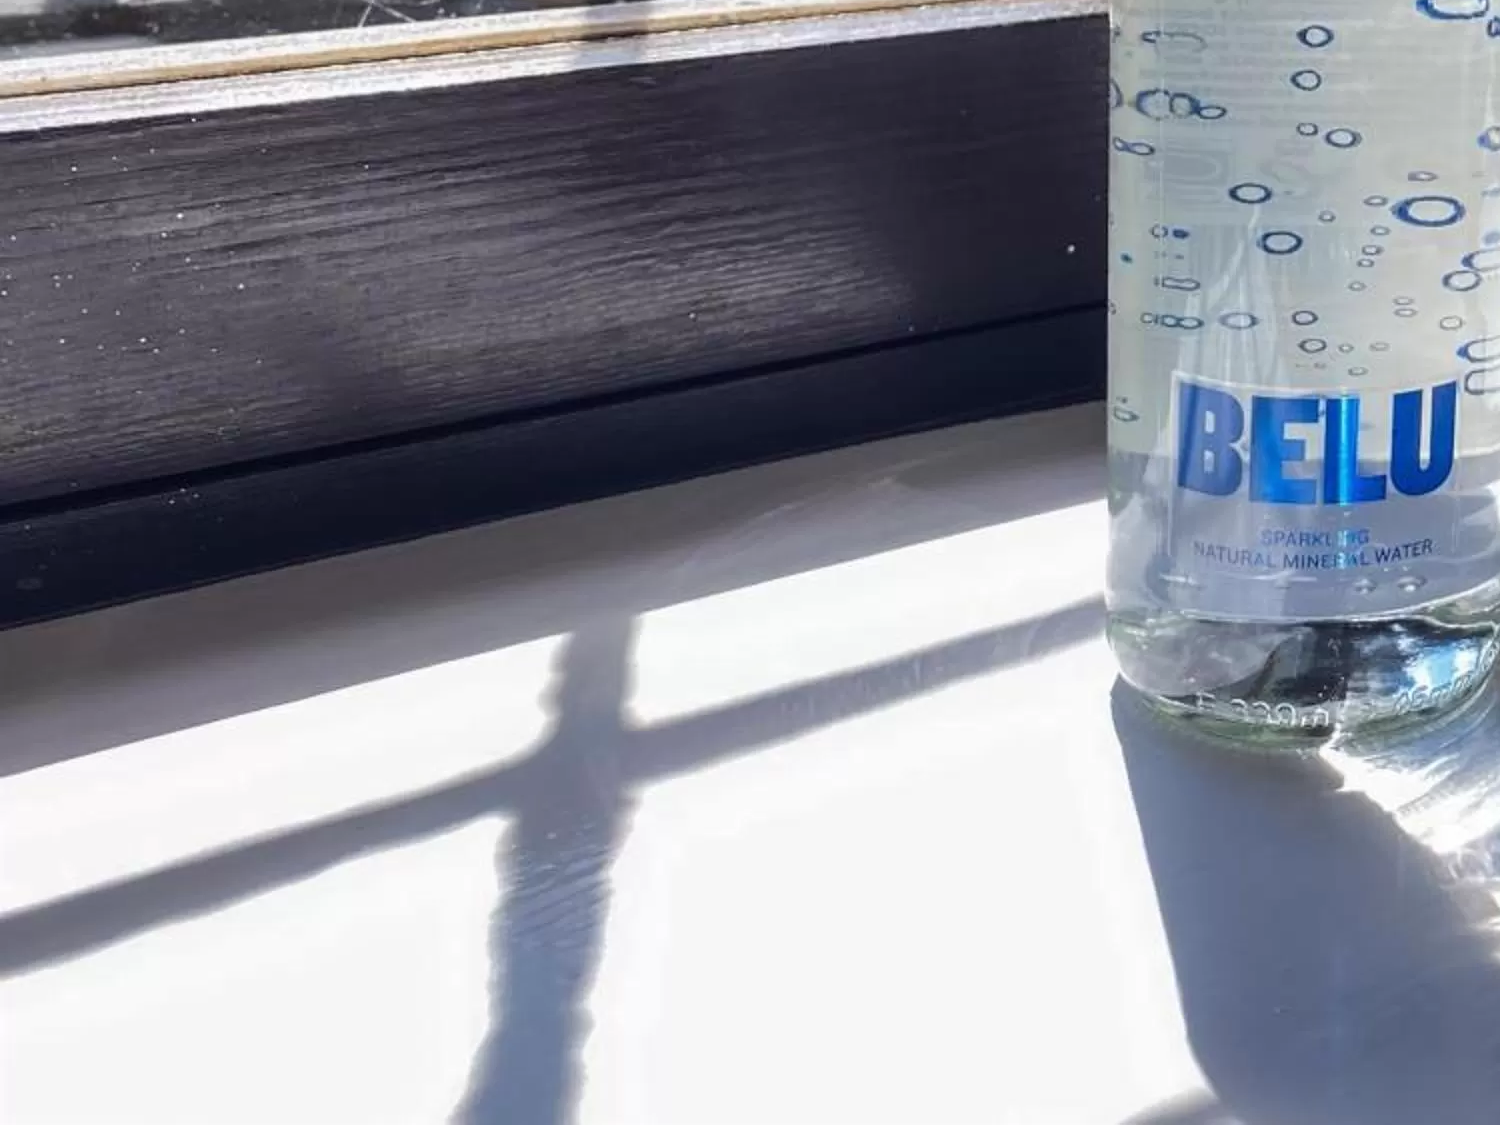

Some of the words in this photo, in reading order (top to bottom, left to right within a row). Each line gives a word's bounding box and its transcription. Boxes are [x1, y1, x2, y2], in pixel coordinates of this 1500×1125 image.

[1176, 379, 1458, 506] BELU
[1193, 540, 1278, 569] NATURAL
[1282, 550, 1372, 571] MINERAL
[1374, 537, 1434, 567] WATER
[1260, 528, 1371, 549] SPARKLNG
